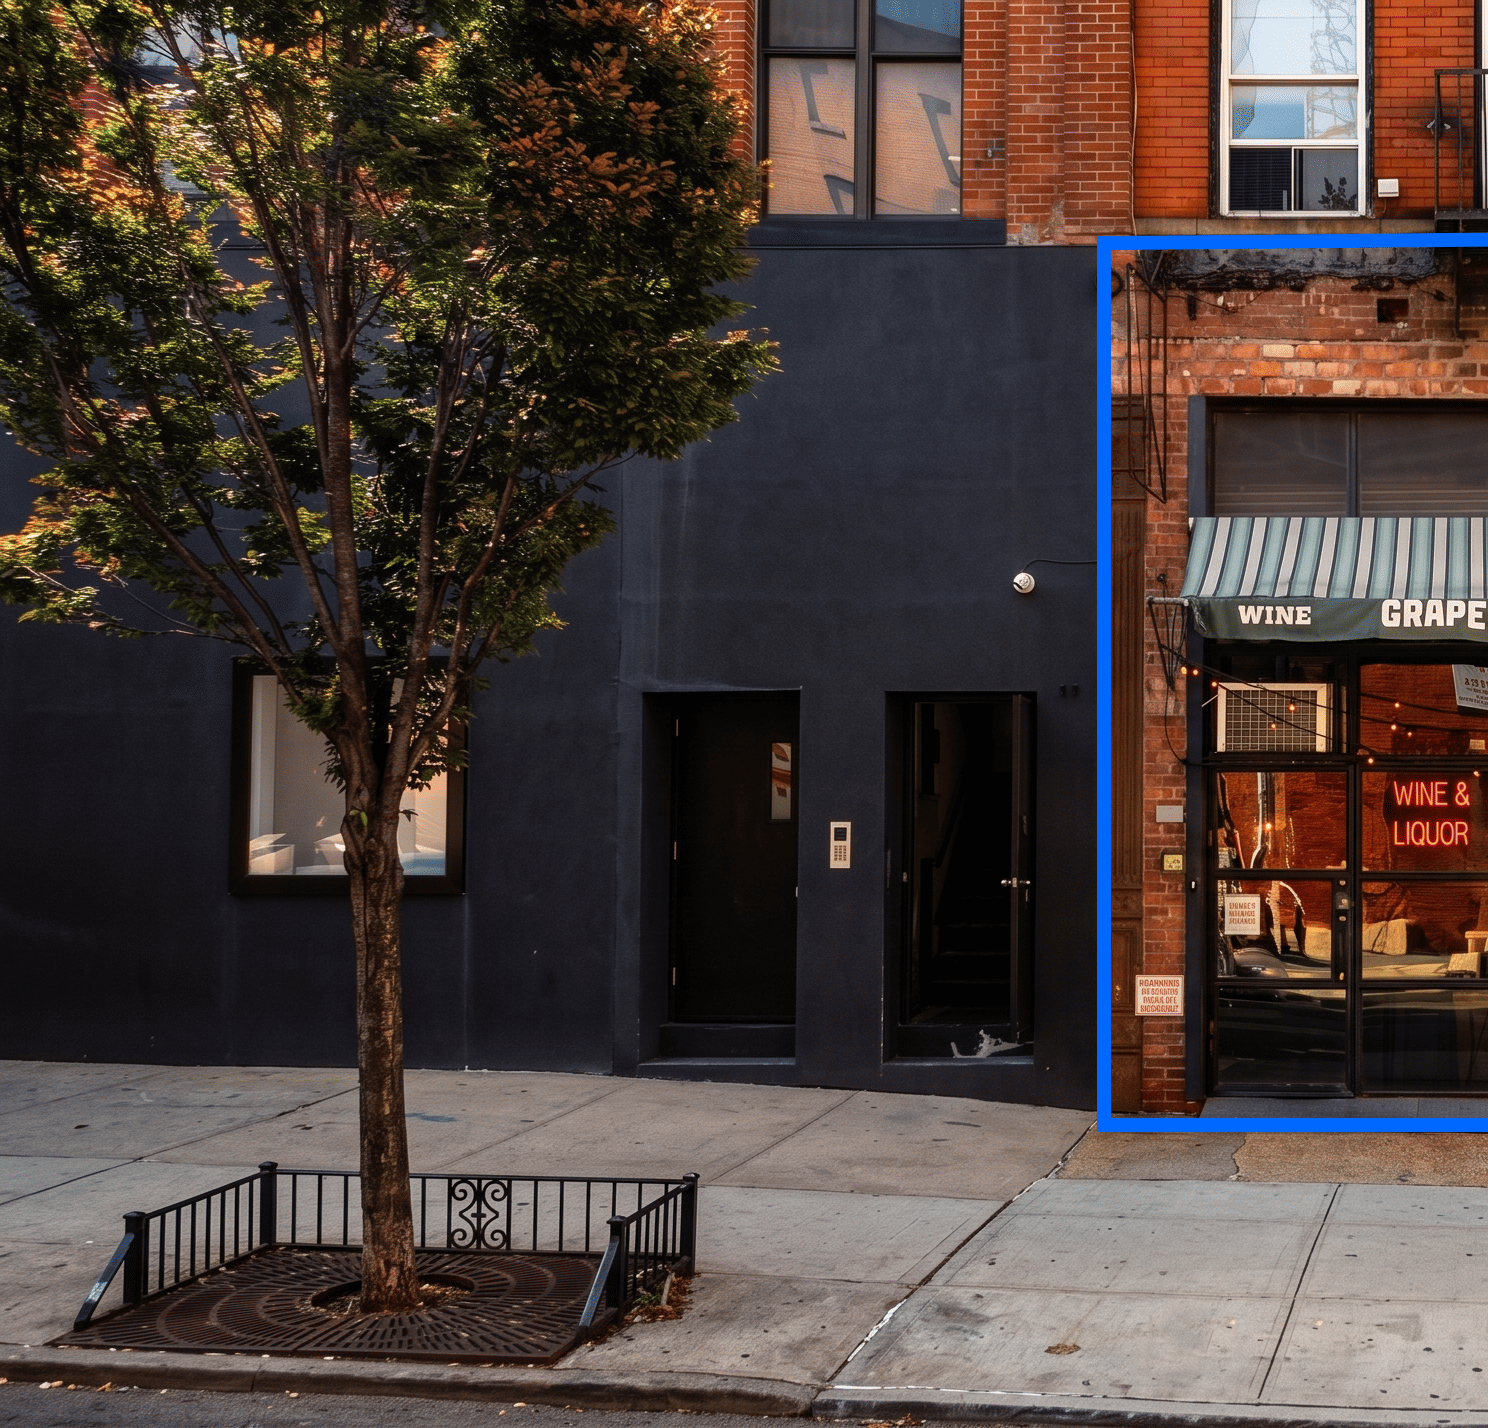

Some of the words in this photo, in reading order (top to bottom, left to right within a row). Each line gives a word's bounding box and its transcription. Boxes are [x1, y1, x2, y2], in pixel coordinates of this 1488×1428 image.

[1238, 605, 1311, 625] WINE
[1393, 781, 1448, 806] WINE
[1455, 781, 1470, 806] &
[1393, 821, 1469, 846] LIQUOR
